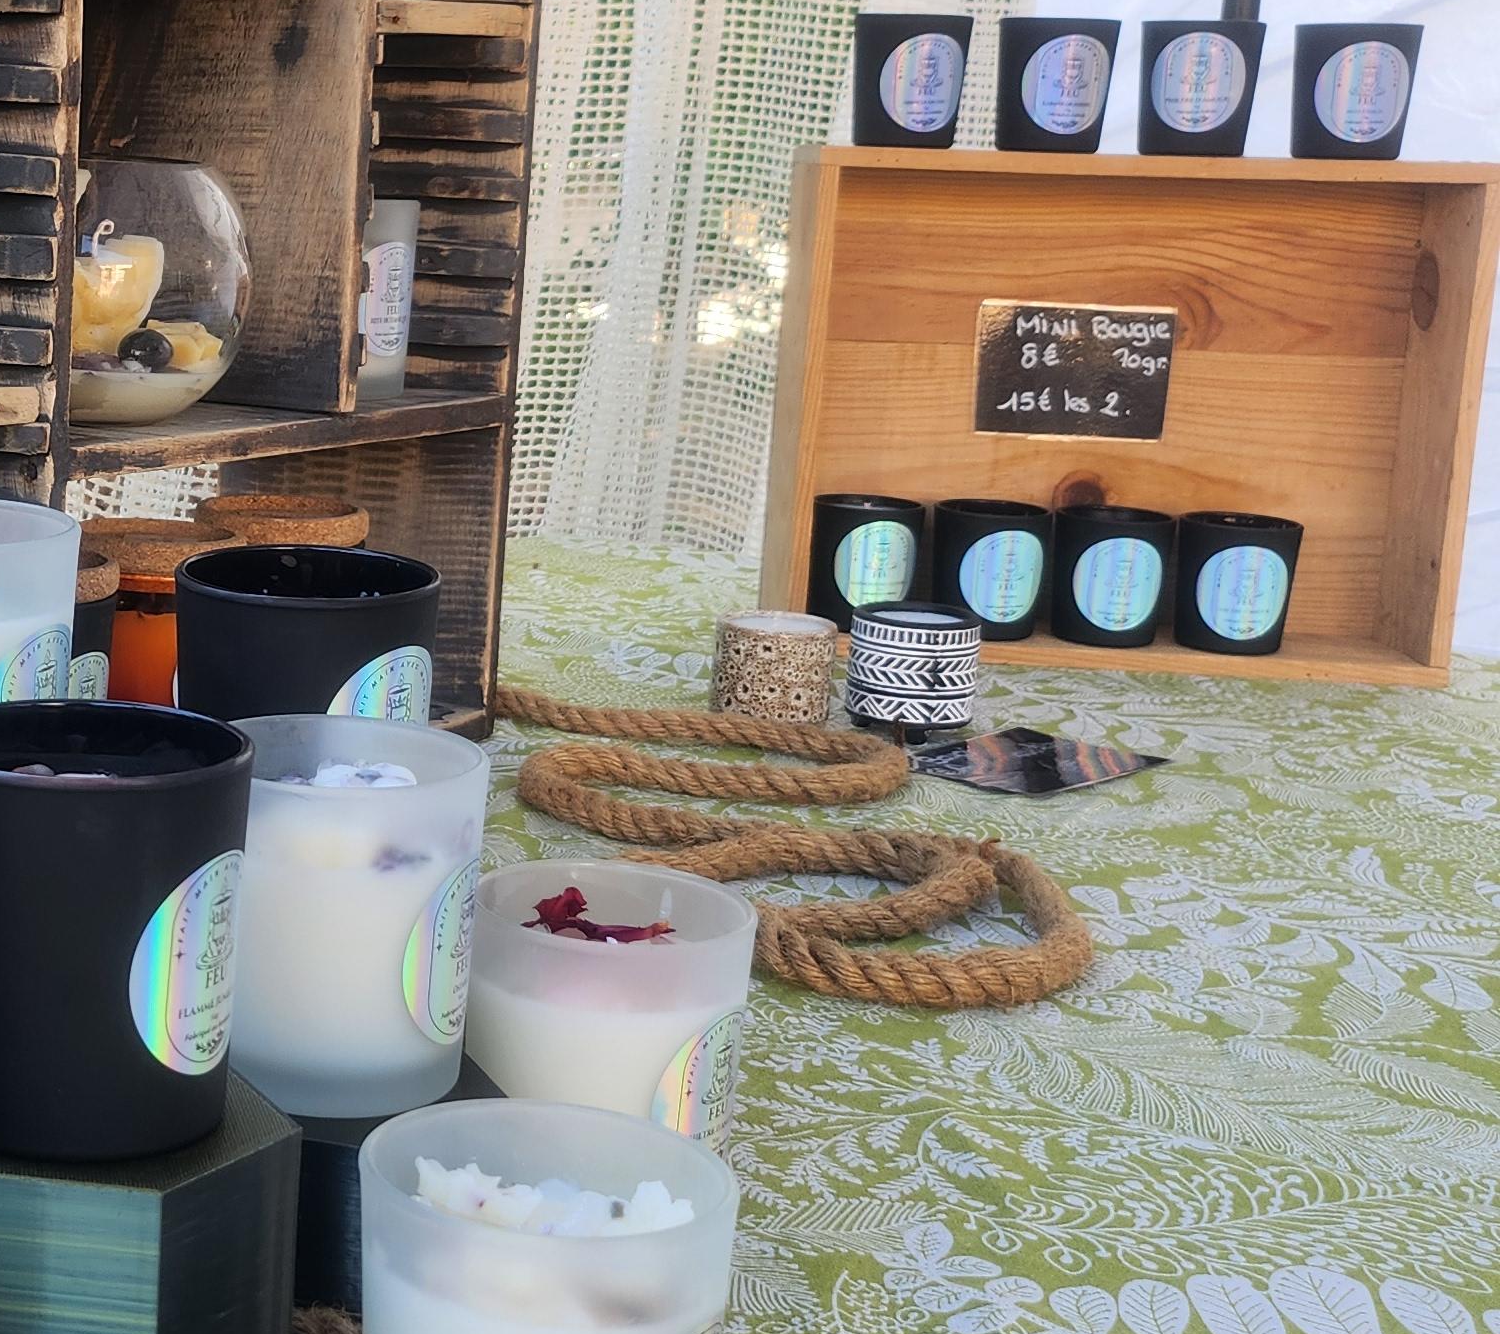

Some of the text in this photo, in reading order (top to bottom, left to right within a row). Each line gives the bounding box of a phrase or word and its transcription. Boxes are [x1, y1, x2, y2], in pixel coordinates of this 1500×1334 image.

[1091, 316, 1171, 347] Bougie
[996, 386, 1052, 413] 15€
[1063, 387, 1091, 413] les
